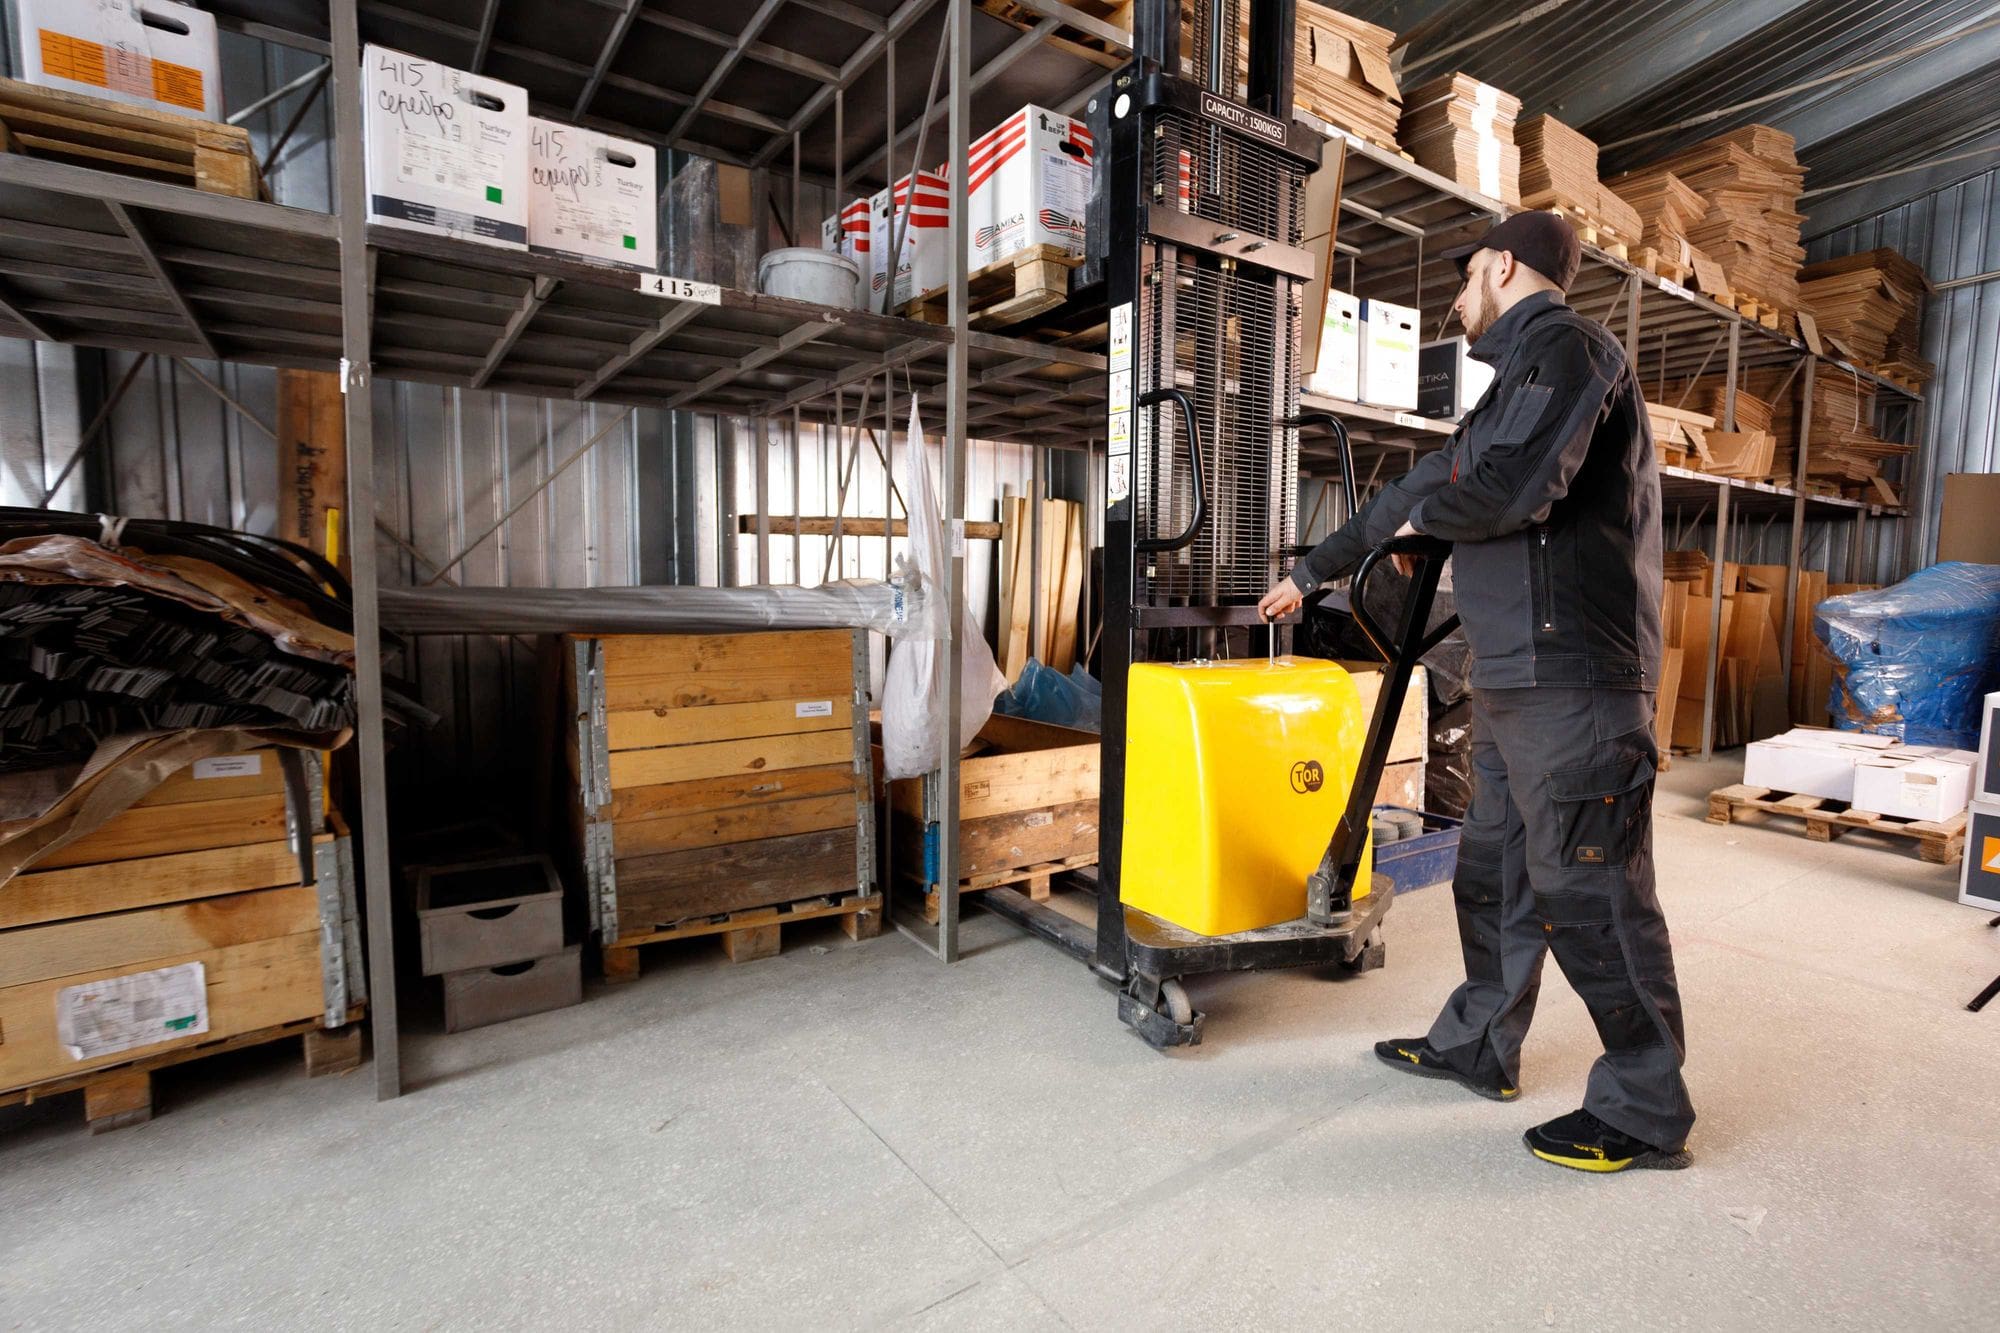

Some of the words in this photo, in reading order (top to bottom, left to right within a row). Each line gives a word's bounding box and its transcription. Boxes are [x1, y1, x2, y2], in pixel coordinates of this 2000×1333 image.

[379, 55, 427, 87] 415
[479, 120, 512, 138] Turkey
[1055, 121, 1066, 130] UP
[531, 126, 565, 158] 415
[616, 177, 644, 191] Turkey
[994, 212, 1025, 234] AMIKA
[654, 278, 693, 298] 415
[1295, 768, 1320, 783] TOR
